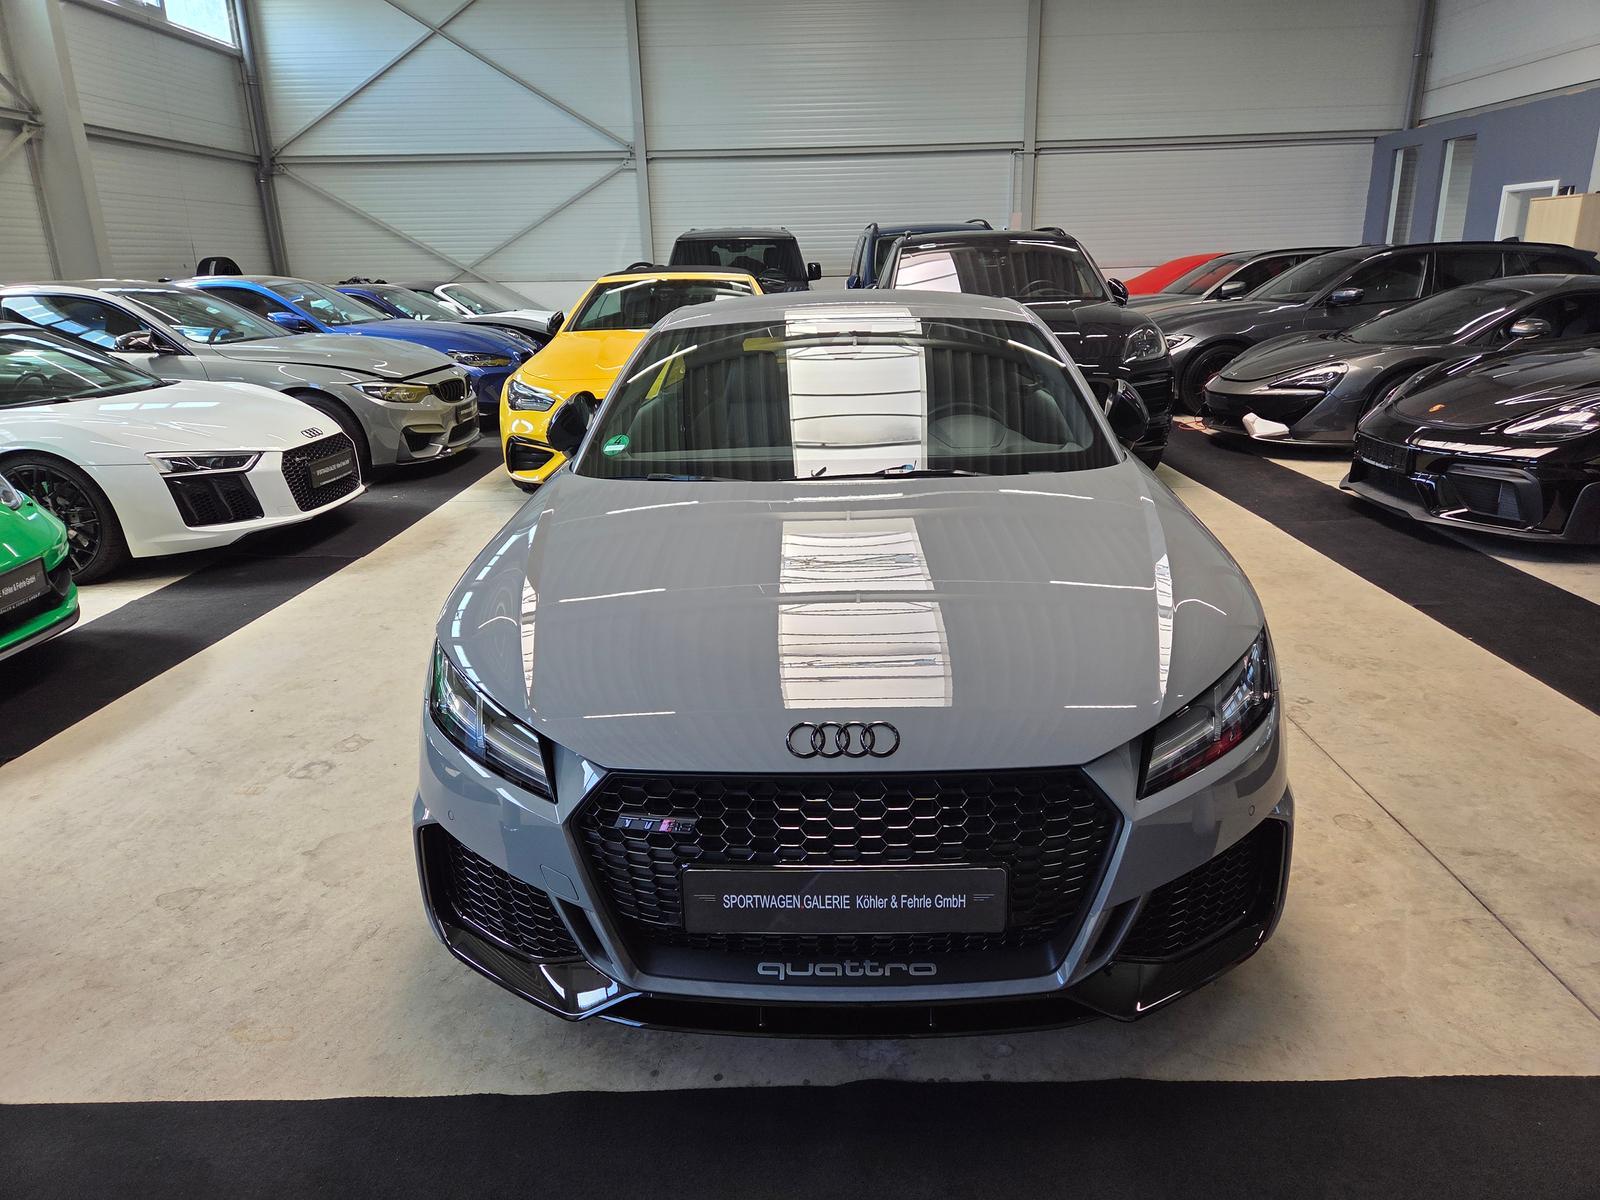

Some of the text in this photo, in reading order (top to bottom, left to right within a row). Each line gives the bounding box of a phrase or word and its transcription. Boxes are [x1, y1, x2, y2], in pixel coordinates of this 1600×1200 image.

[856, 895, 888, 909] Köhler
[890, 895, 898, 908] &
[901, 895, 932, 908] Fehrle
[935, 894, 966, 908] GmbH
[757, 960, 937, 980] quattro
